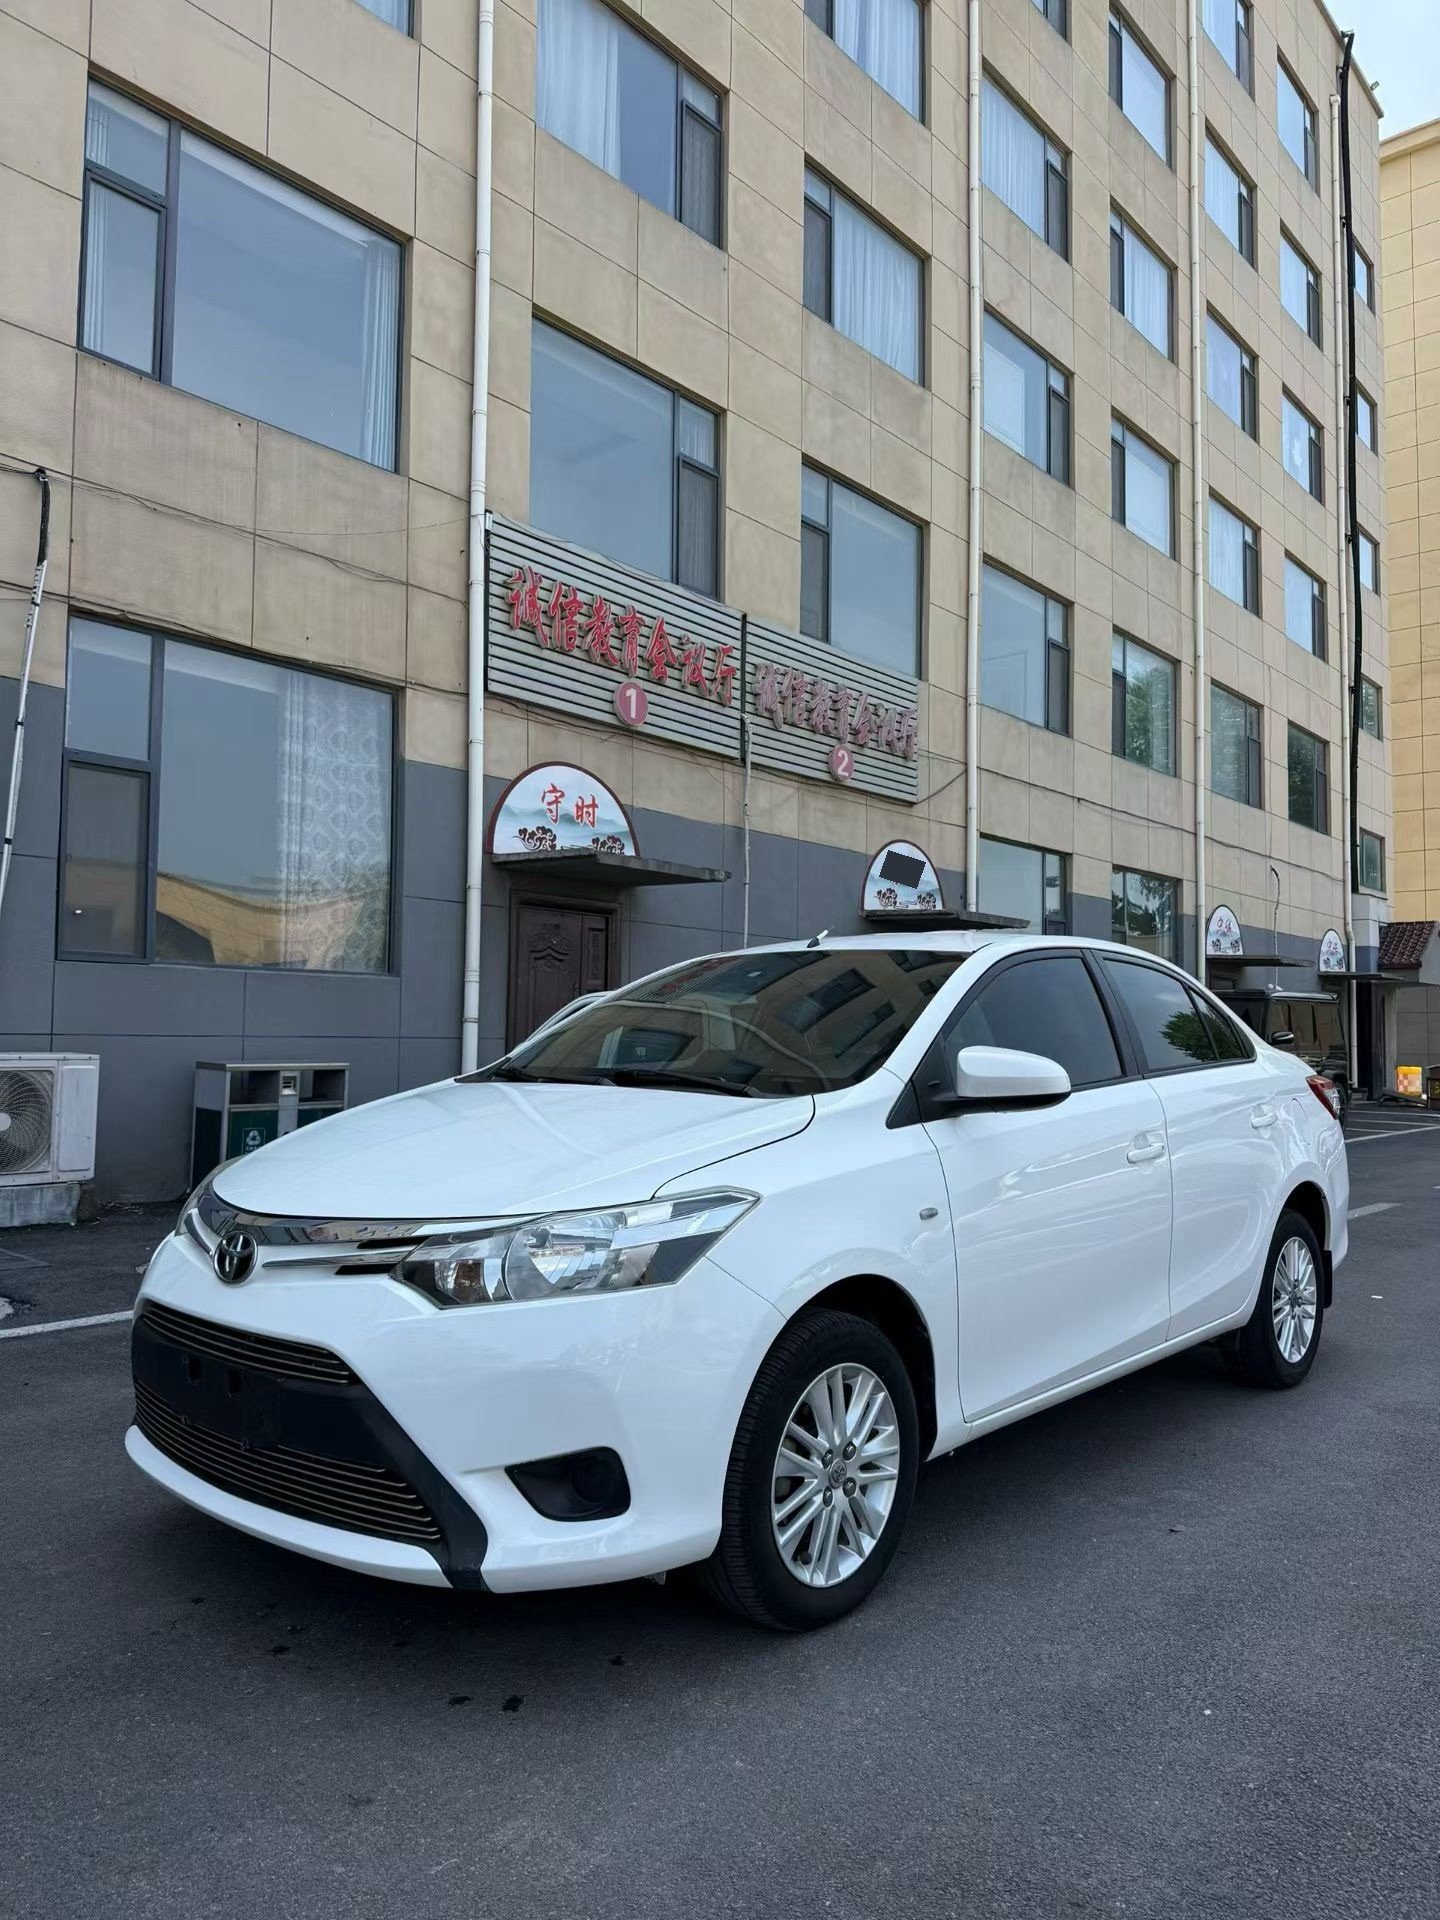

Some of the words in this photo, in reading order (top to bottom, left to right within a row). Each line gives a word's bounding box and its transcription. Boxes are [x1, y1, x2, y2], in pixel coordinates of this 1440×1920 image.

[504, 565, 737, 706] 诚信教育会议厅
[625, 688, 637, 719] 1
[837, 749, 849, 777] 2
[541, 782, 599, 829] 守时
